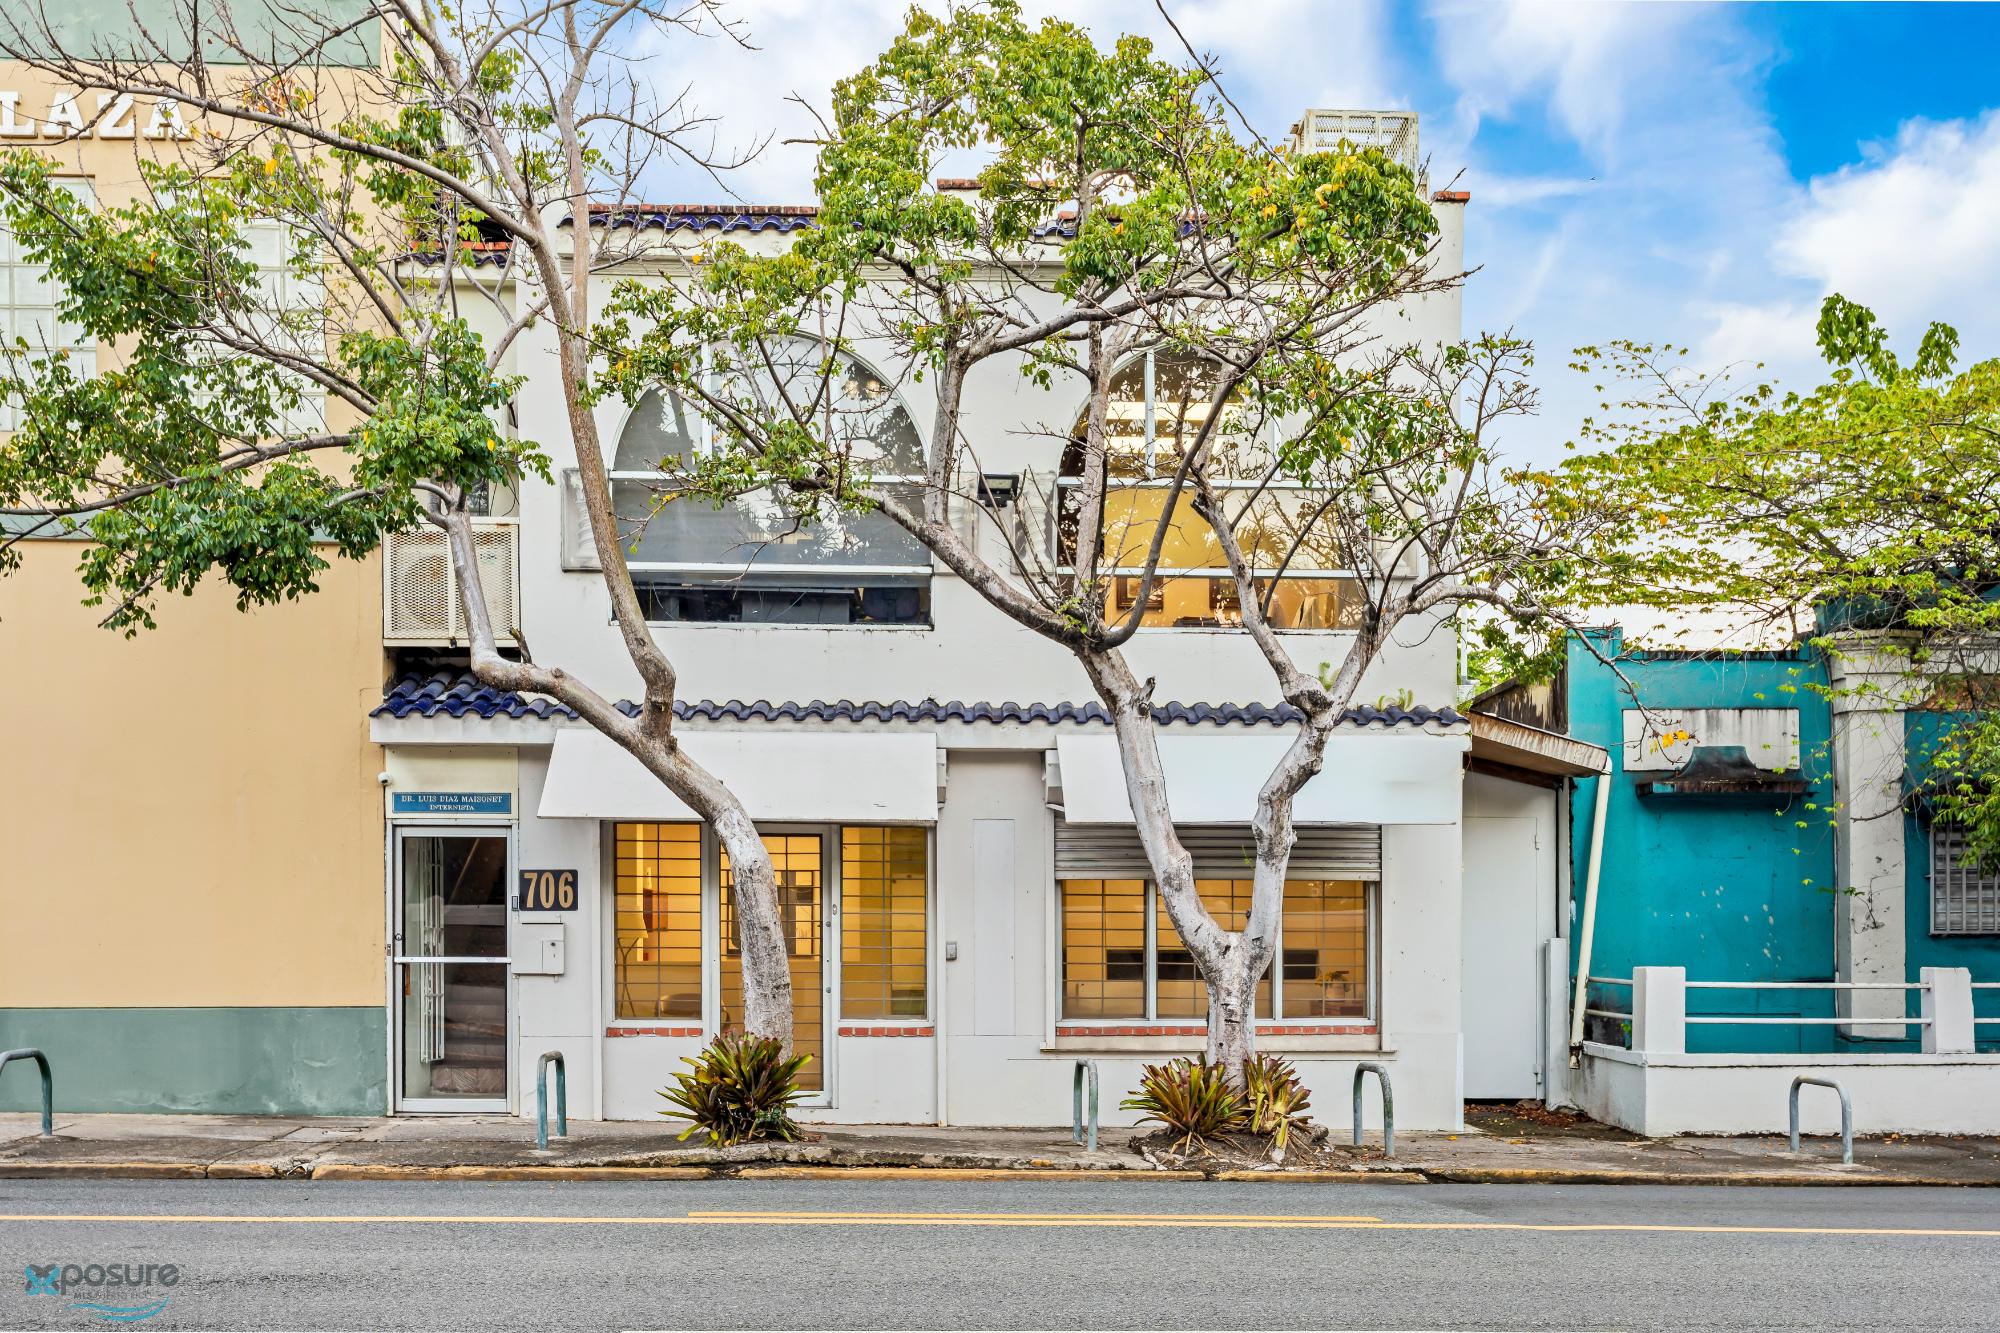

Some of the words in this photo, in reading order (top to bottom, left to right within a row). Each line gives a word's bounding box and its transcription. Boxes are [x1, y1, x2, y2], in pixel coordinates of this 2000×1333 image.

[401, 795, 415, 803] DR.
[418, 795, 437, 803] LUIS
[440, 795, 459, 803] DIAZ
[524, 871, 574, 909] 706
